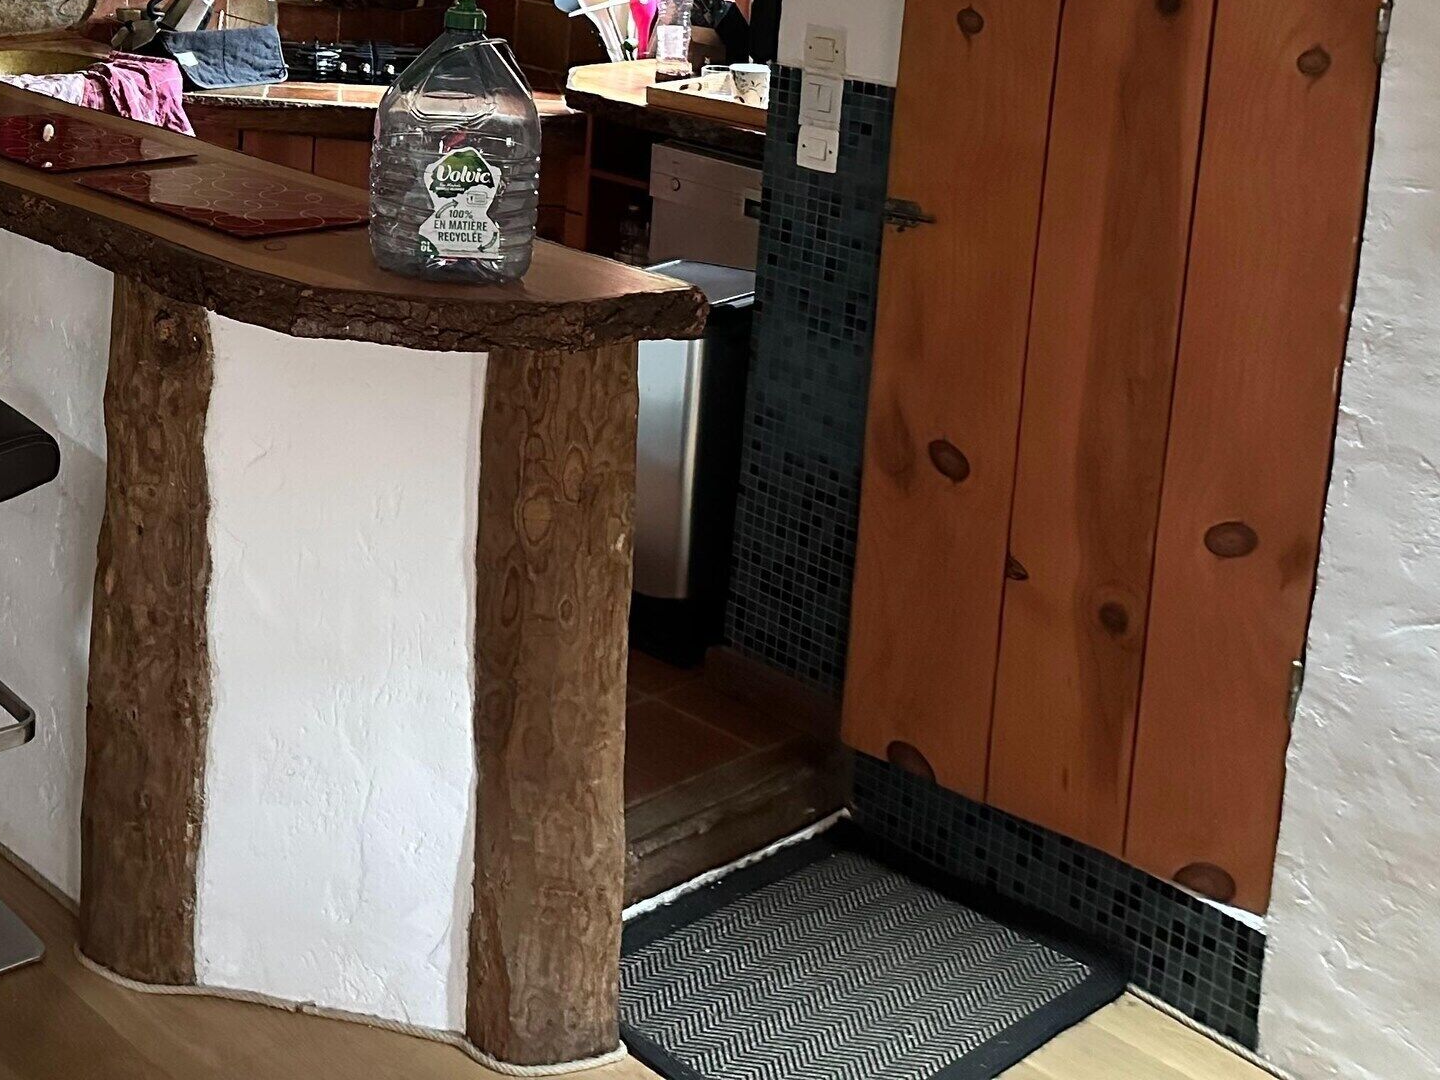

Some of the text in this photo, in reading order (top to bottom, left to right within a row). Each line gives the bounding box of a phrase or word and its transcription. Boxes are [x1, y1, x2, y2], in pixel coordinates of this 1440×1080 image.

[436, 165, 491, 184] Volvic
[449, 209, 474, 220] 100%
[434, 220, 446, 230] EN
[438, 231, 482, 243] RECYCLÉE
[420, 241, 433, 253] 6L
